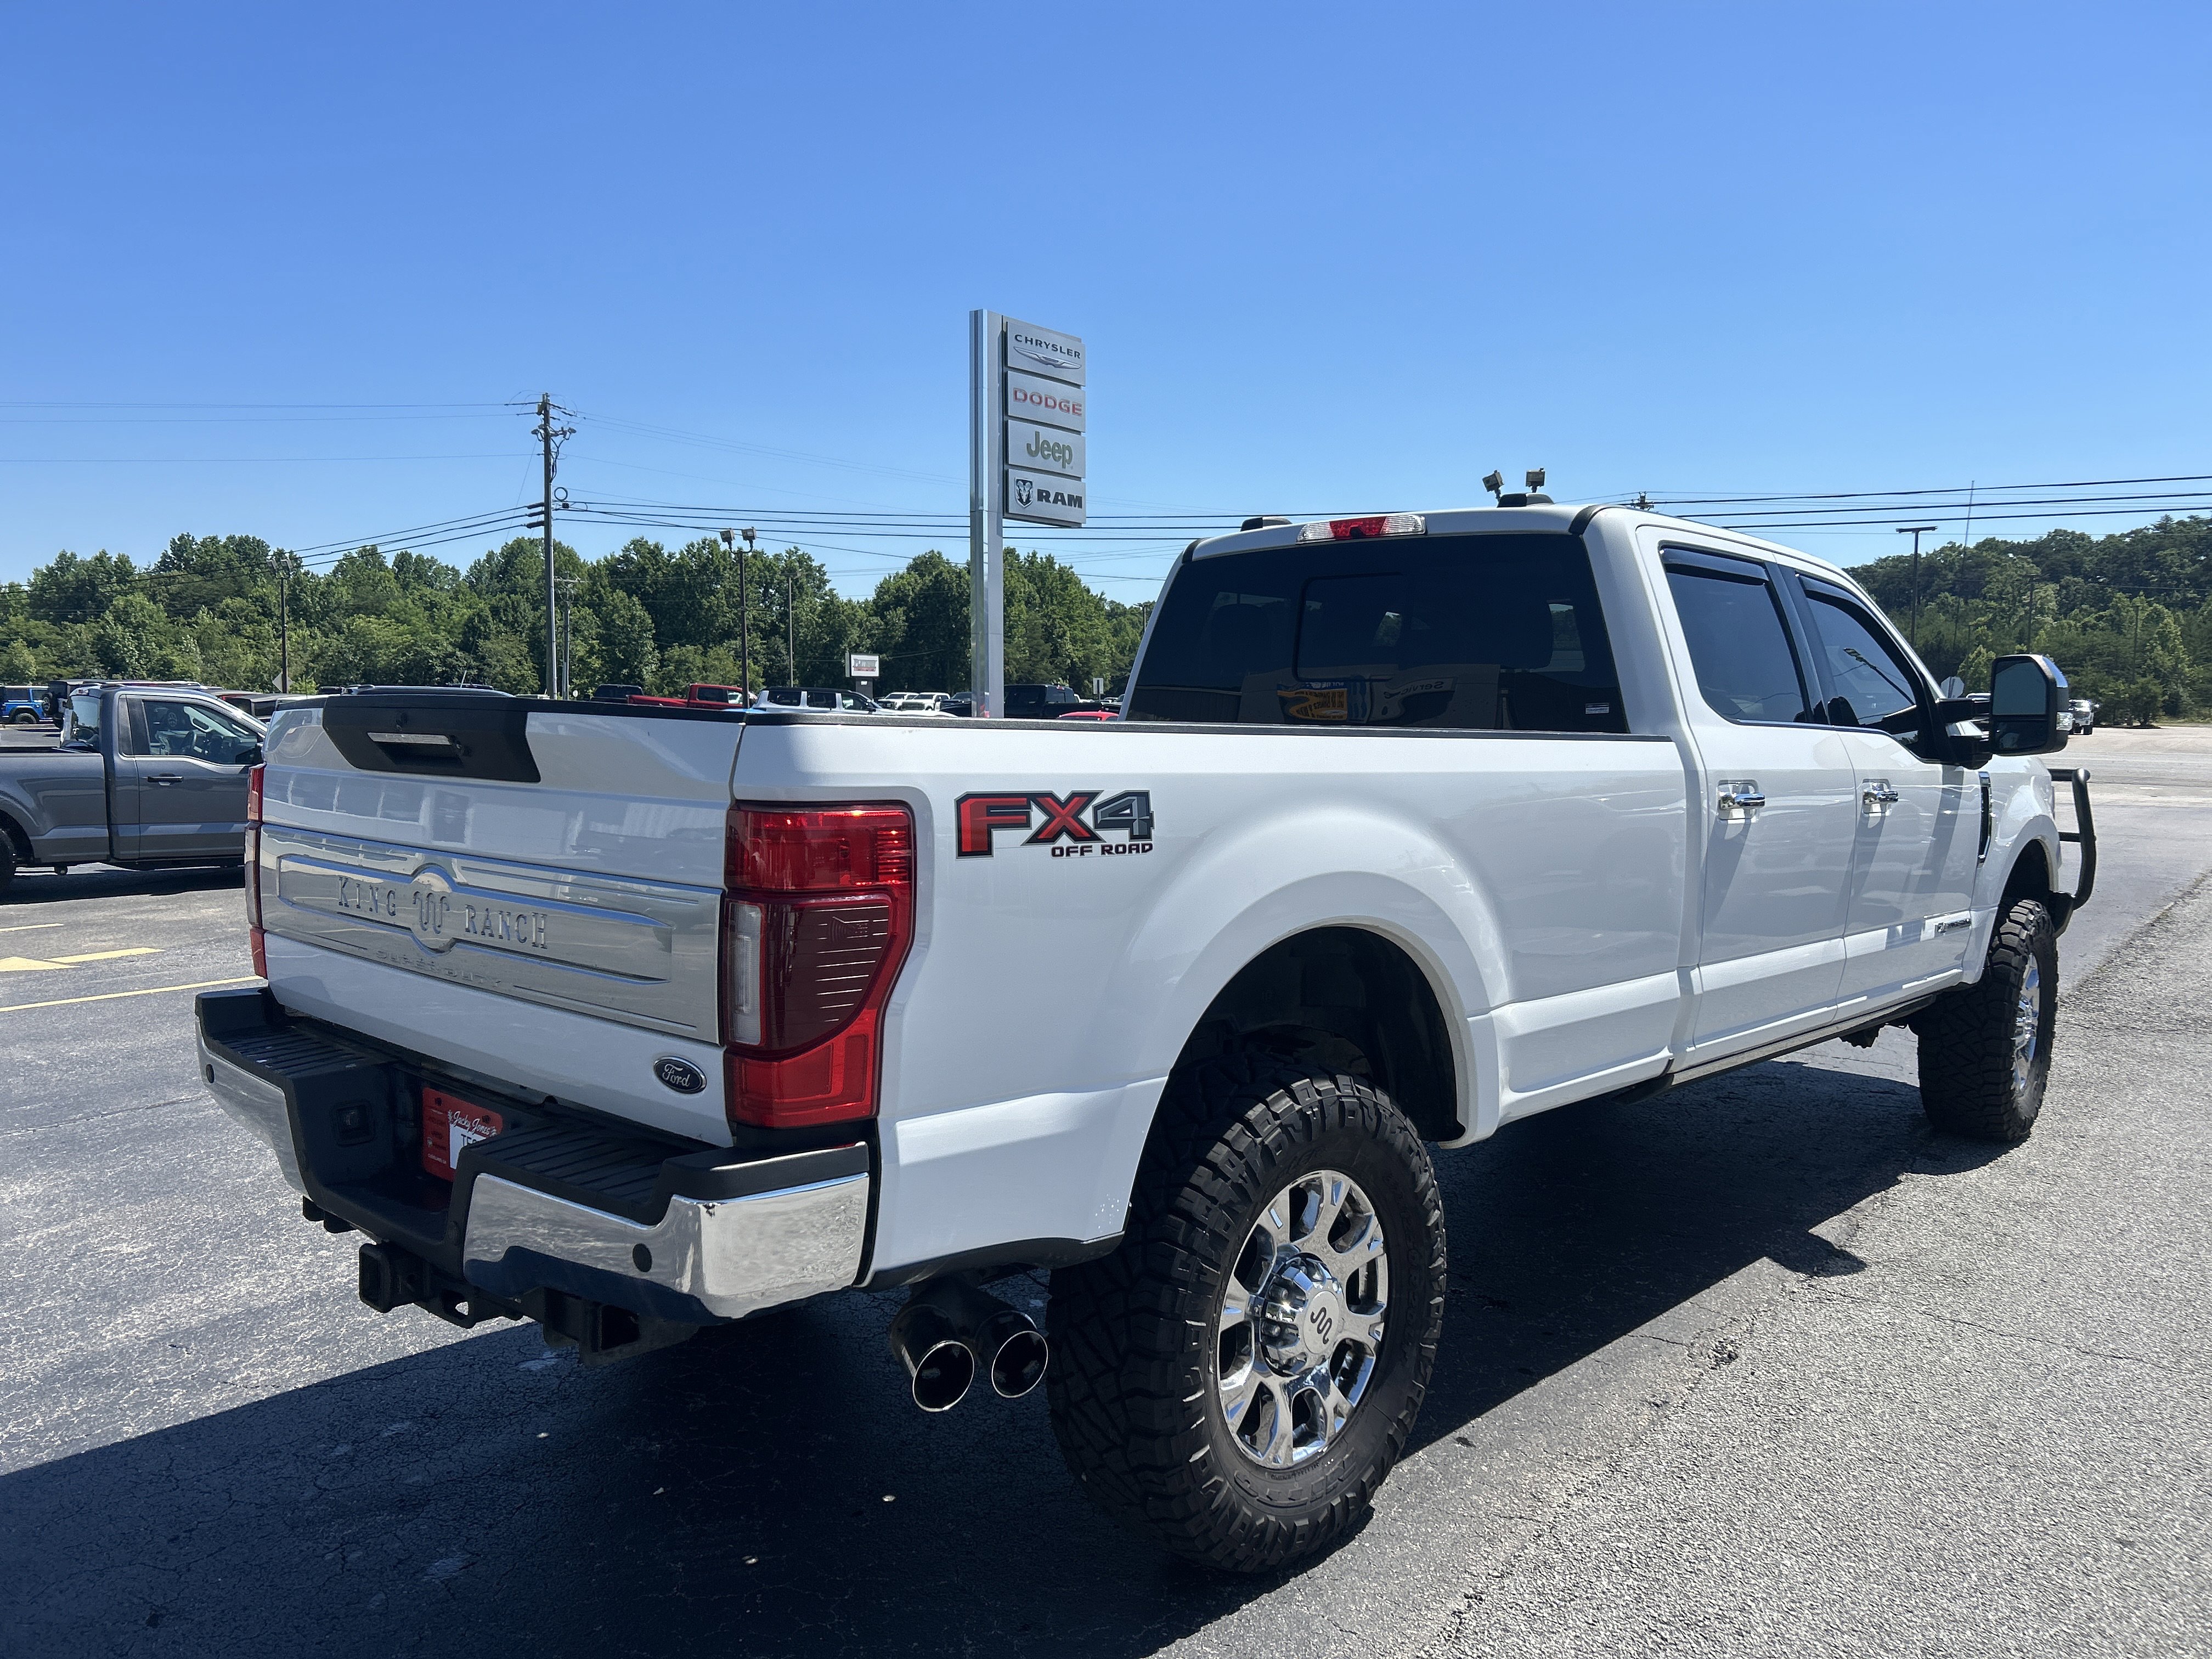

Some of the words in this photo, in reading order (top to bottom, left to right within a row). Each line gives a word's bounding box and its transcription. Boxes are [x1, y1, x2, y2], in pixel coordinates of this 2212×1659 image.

[1014, 334, 1081, 359] CHRYSLER
[1013, 387, 1082, 416] DODGE
[1026, 431, 1073, 469] Jeep
[1037, 488, 1082, 509] RAM
[955, 790, 1154, 859] FX4
[1051, 844, 1093, 857] OFF
[1100, 843, 1153, 856] ROAD
[338, 876, 396, 916] KING
[464, 904, 548, 949] RANCH
[444, 967, 501, 987] DUTY
[662, 1063, 691, 1087] Ford
[453, 1111, 471, 1133] Jacky
[472, 1118, 490, 1135] Jones
